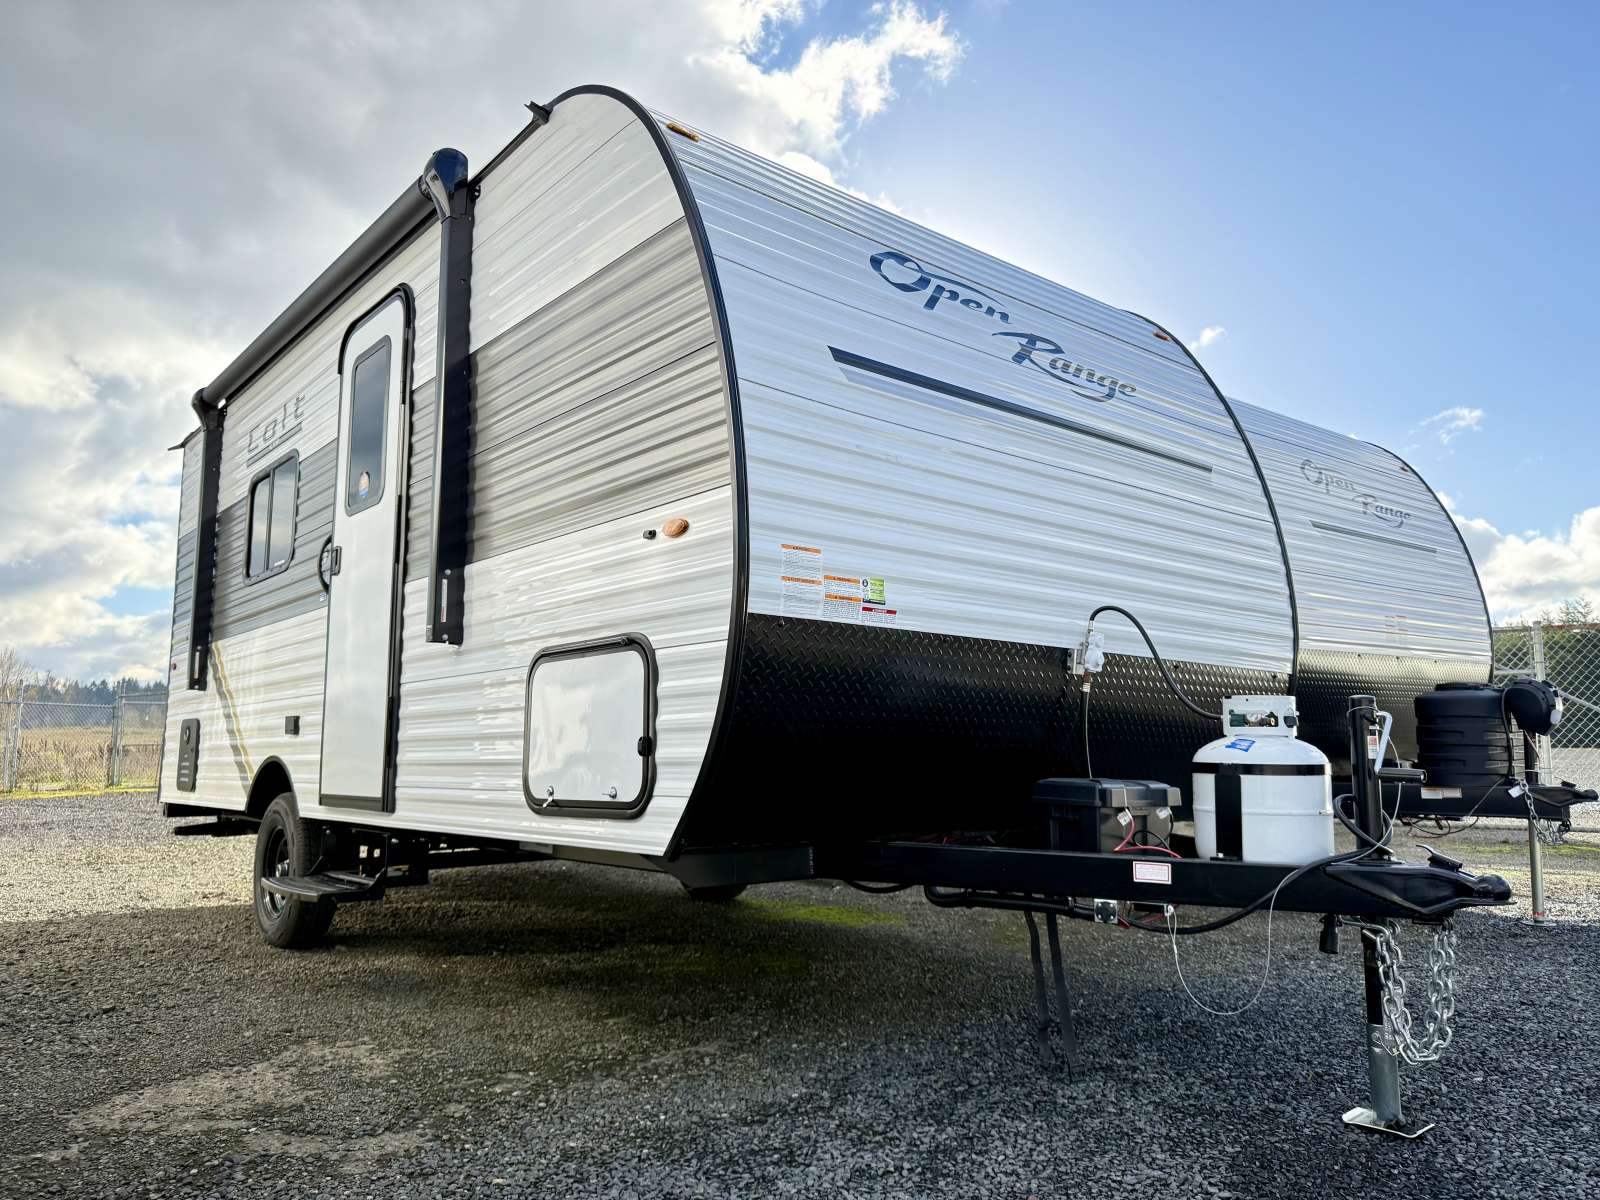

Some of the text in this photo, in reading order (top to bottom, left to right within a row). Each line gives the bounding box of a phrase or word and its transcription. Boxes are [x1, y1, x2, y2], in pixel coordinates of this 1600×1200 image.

[869, 251, 1012, 324] Open
[992, 332, 1137, 402] Range
[1300, 459, 1357, 494] Open
[1352, 493, 1412, 528] Range
